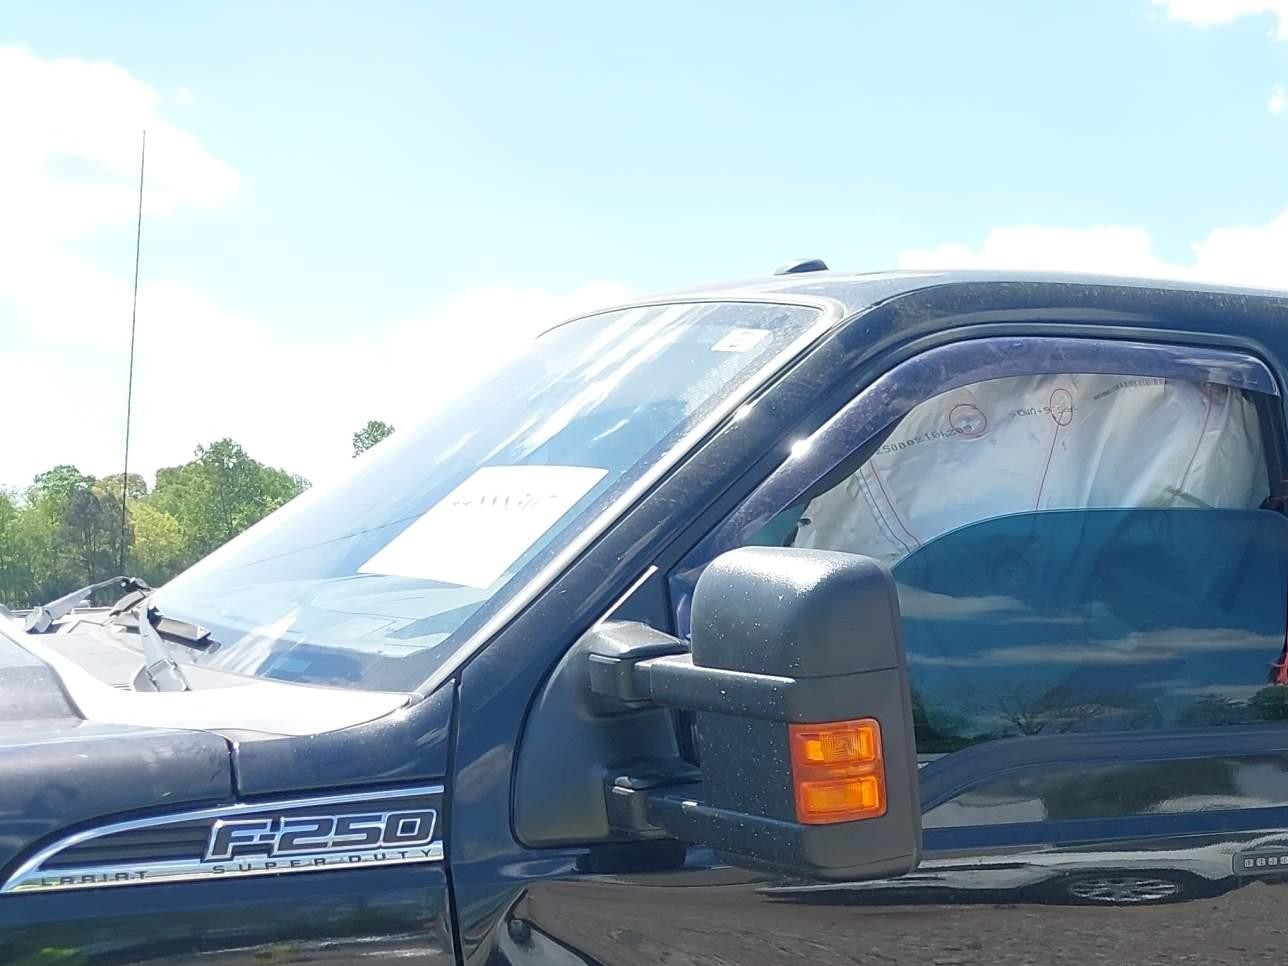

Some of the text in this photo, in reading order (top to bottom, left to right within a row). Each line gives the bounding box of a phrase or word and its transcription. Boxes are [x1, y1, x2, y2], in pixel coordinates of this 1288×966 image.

[206, 809, 438, 861] F-250
[211, 848, 433, 875] SUPER DUTY
[40, 869, 149, 887] LARIAT
